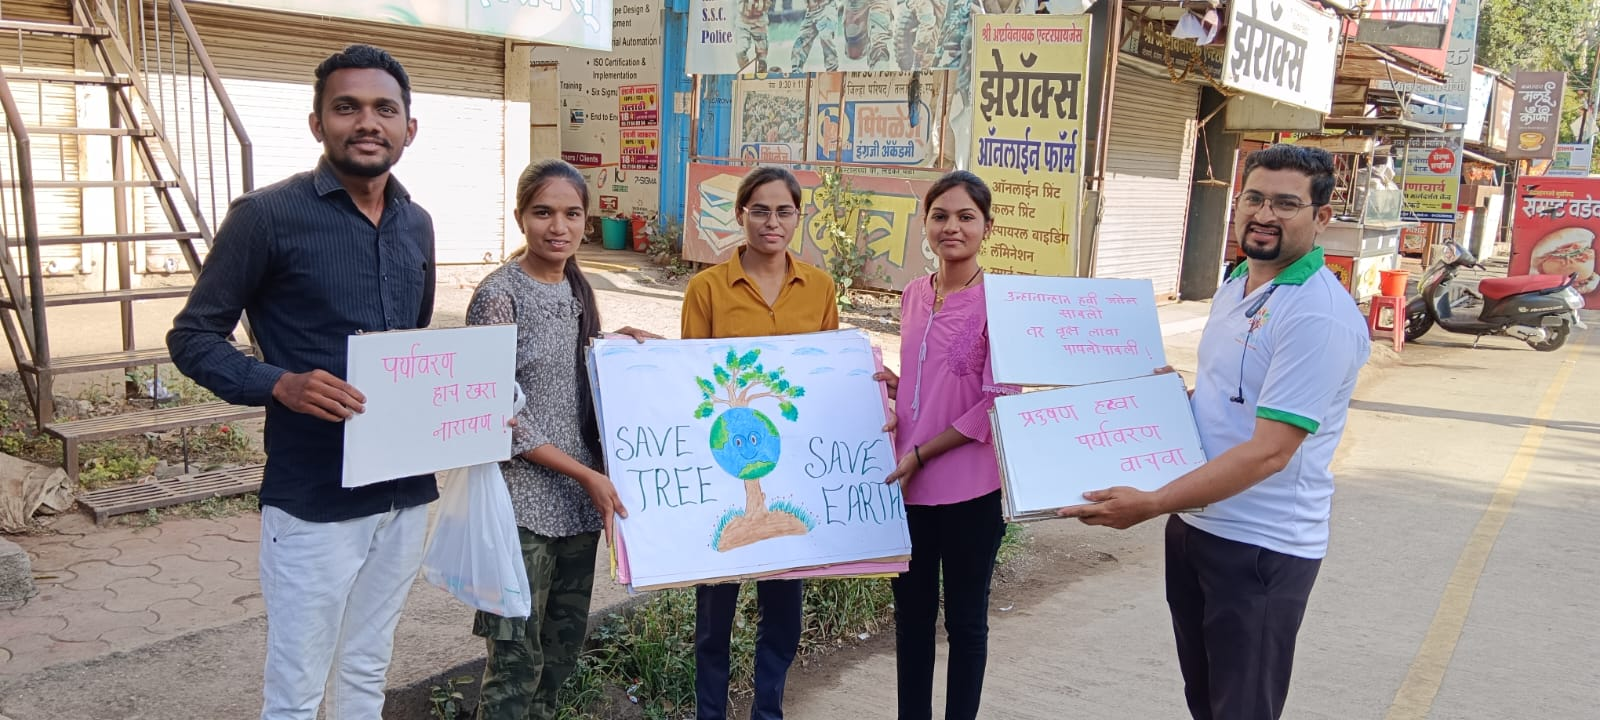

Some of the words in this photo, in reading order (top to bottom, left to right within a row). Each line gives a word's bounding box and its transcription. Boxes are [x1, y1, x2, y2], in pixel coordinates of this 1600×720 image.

[623, 6, 643, 15] Design
[702, 7, 726, 21] S.S.C.
[702, 30, 733, 43] Police
[982, 23, 991, 42] श्री
[622, 37, 657, 47] Automation
[593, 58, 603, 67] ISO
[605, 57, 640, 67] Certification
[593, 71, 637, 82] Implementation
[980, 48, 1082, 122] झेरॉक्स
[560, 81, 582, 92] Training
[591, 88, 600, 97] Six
[590, 113, 601, 121] End
[603, 113, 608, 121] to
[580, 154, 598, 163] Clients
[978, 126, 1041, 175] ऑनलाईन
[1045, 129, 1078, 174] फॉर्म
[992, 179, 1038, 199] ऑनलाईन
[1043, 181, 1061, 199] प्रिंट
[992, 203, 1015, 216] कलर
[1018, 203, 1036, 219] प्रिंट
[1027, 326, 1045, 338] तर
[1089, 328, 1120, 338] लावा
[381, 343, 457, 383] पर्यावरण
[432, 383, 459, 406] हाच
[465, 382, 497, 399] खरा
[432, 414, 491, 441] नारायण
[1075, 420, 1162, 450] पर्यावरण
[616, 425, 694, 461] SAVE
[805, 436, 883, 479] SAVE
[626, 466, 718, 512] TREE
[821, 481, 907, 525] EARTH
